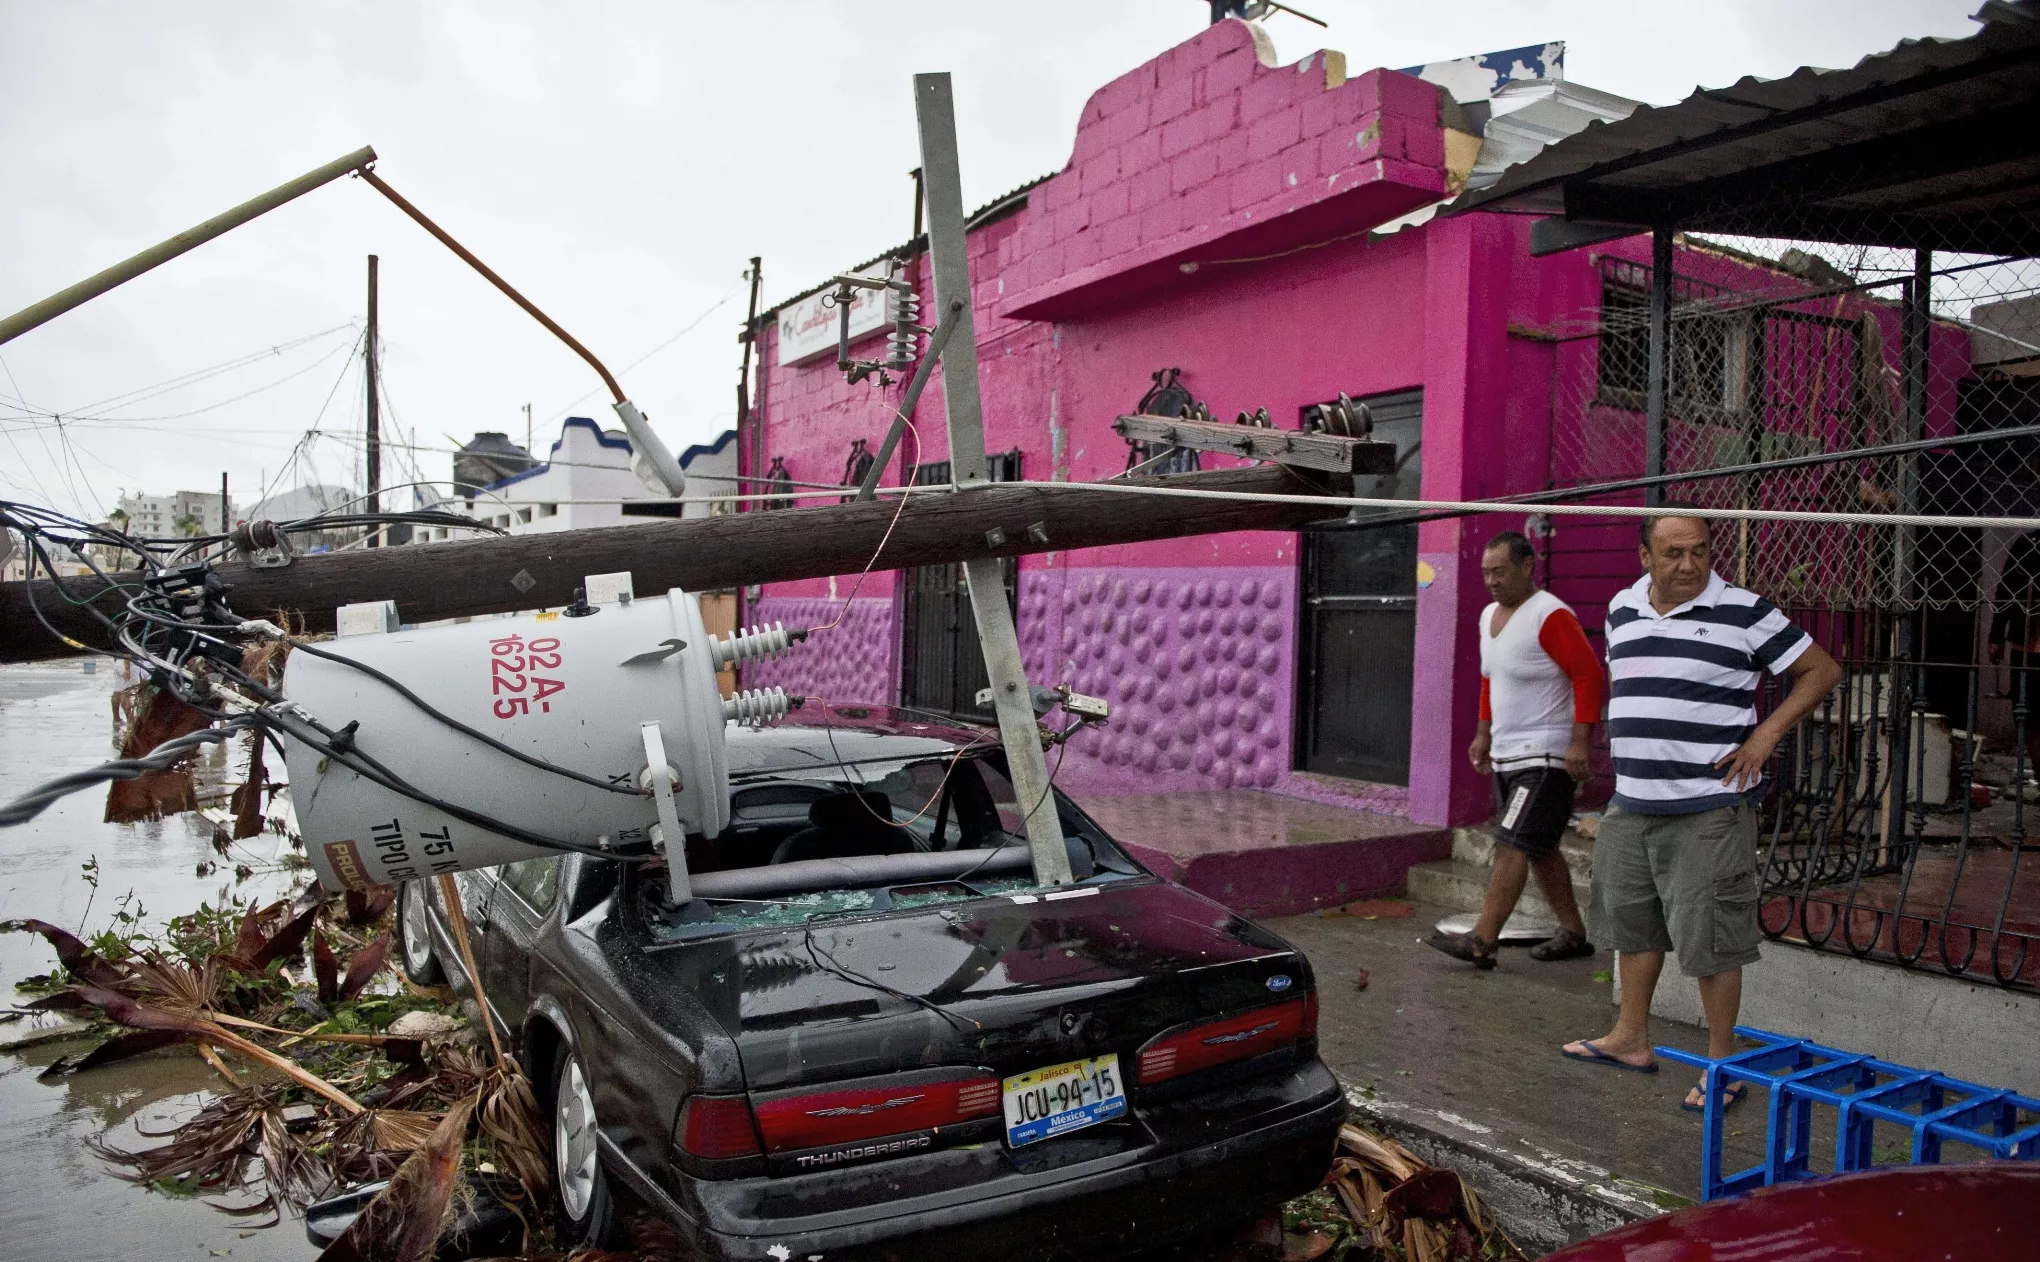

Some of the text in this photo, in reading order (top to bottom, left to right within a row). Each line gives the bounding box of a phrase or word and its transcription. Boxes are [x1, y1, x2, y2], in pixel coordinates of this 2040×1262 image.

[528, 638, 561, 671] 02
[489, 633, 528, 719] 16225
[371, 818, 410, 864] TIPO
[420, 826, 454, 855] 75
[1039, 1066, 1069, 1081] Jalisco
[1014, 1068, 1116, 1125] JCU-94-15
[1051, 1110, 1085, 1127] México
[796, 1136, 930, 1167] THUNDERBIRD
